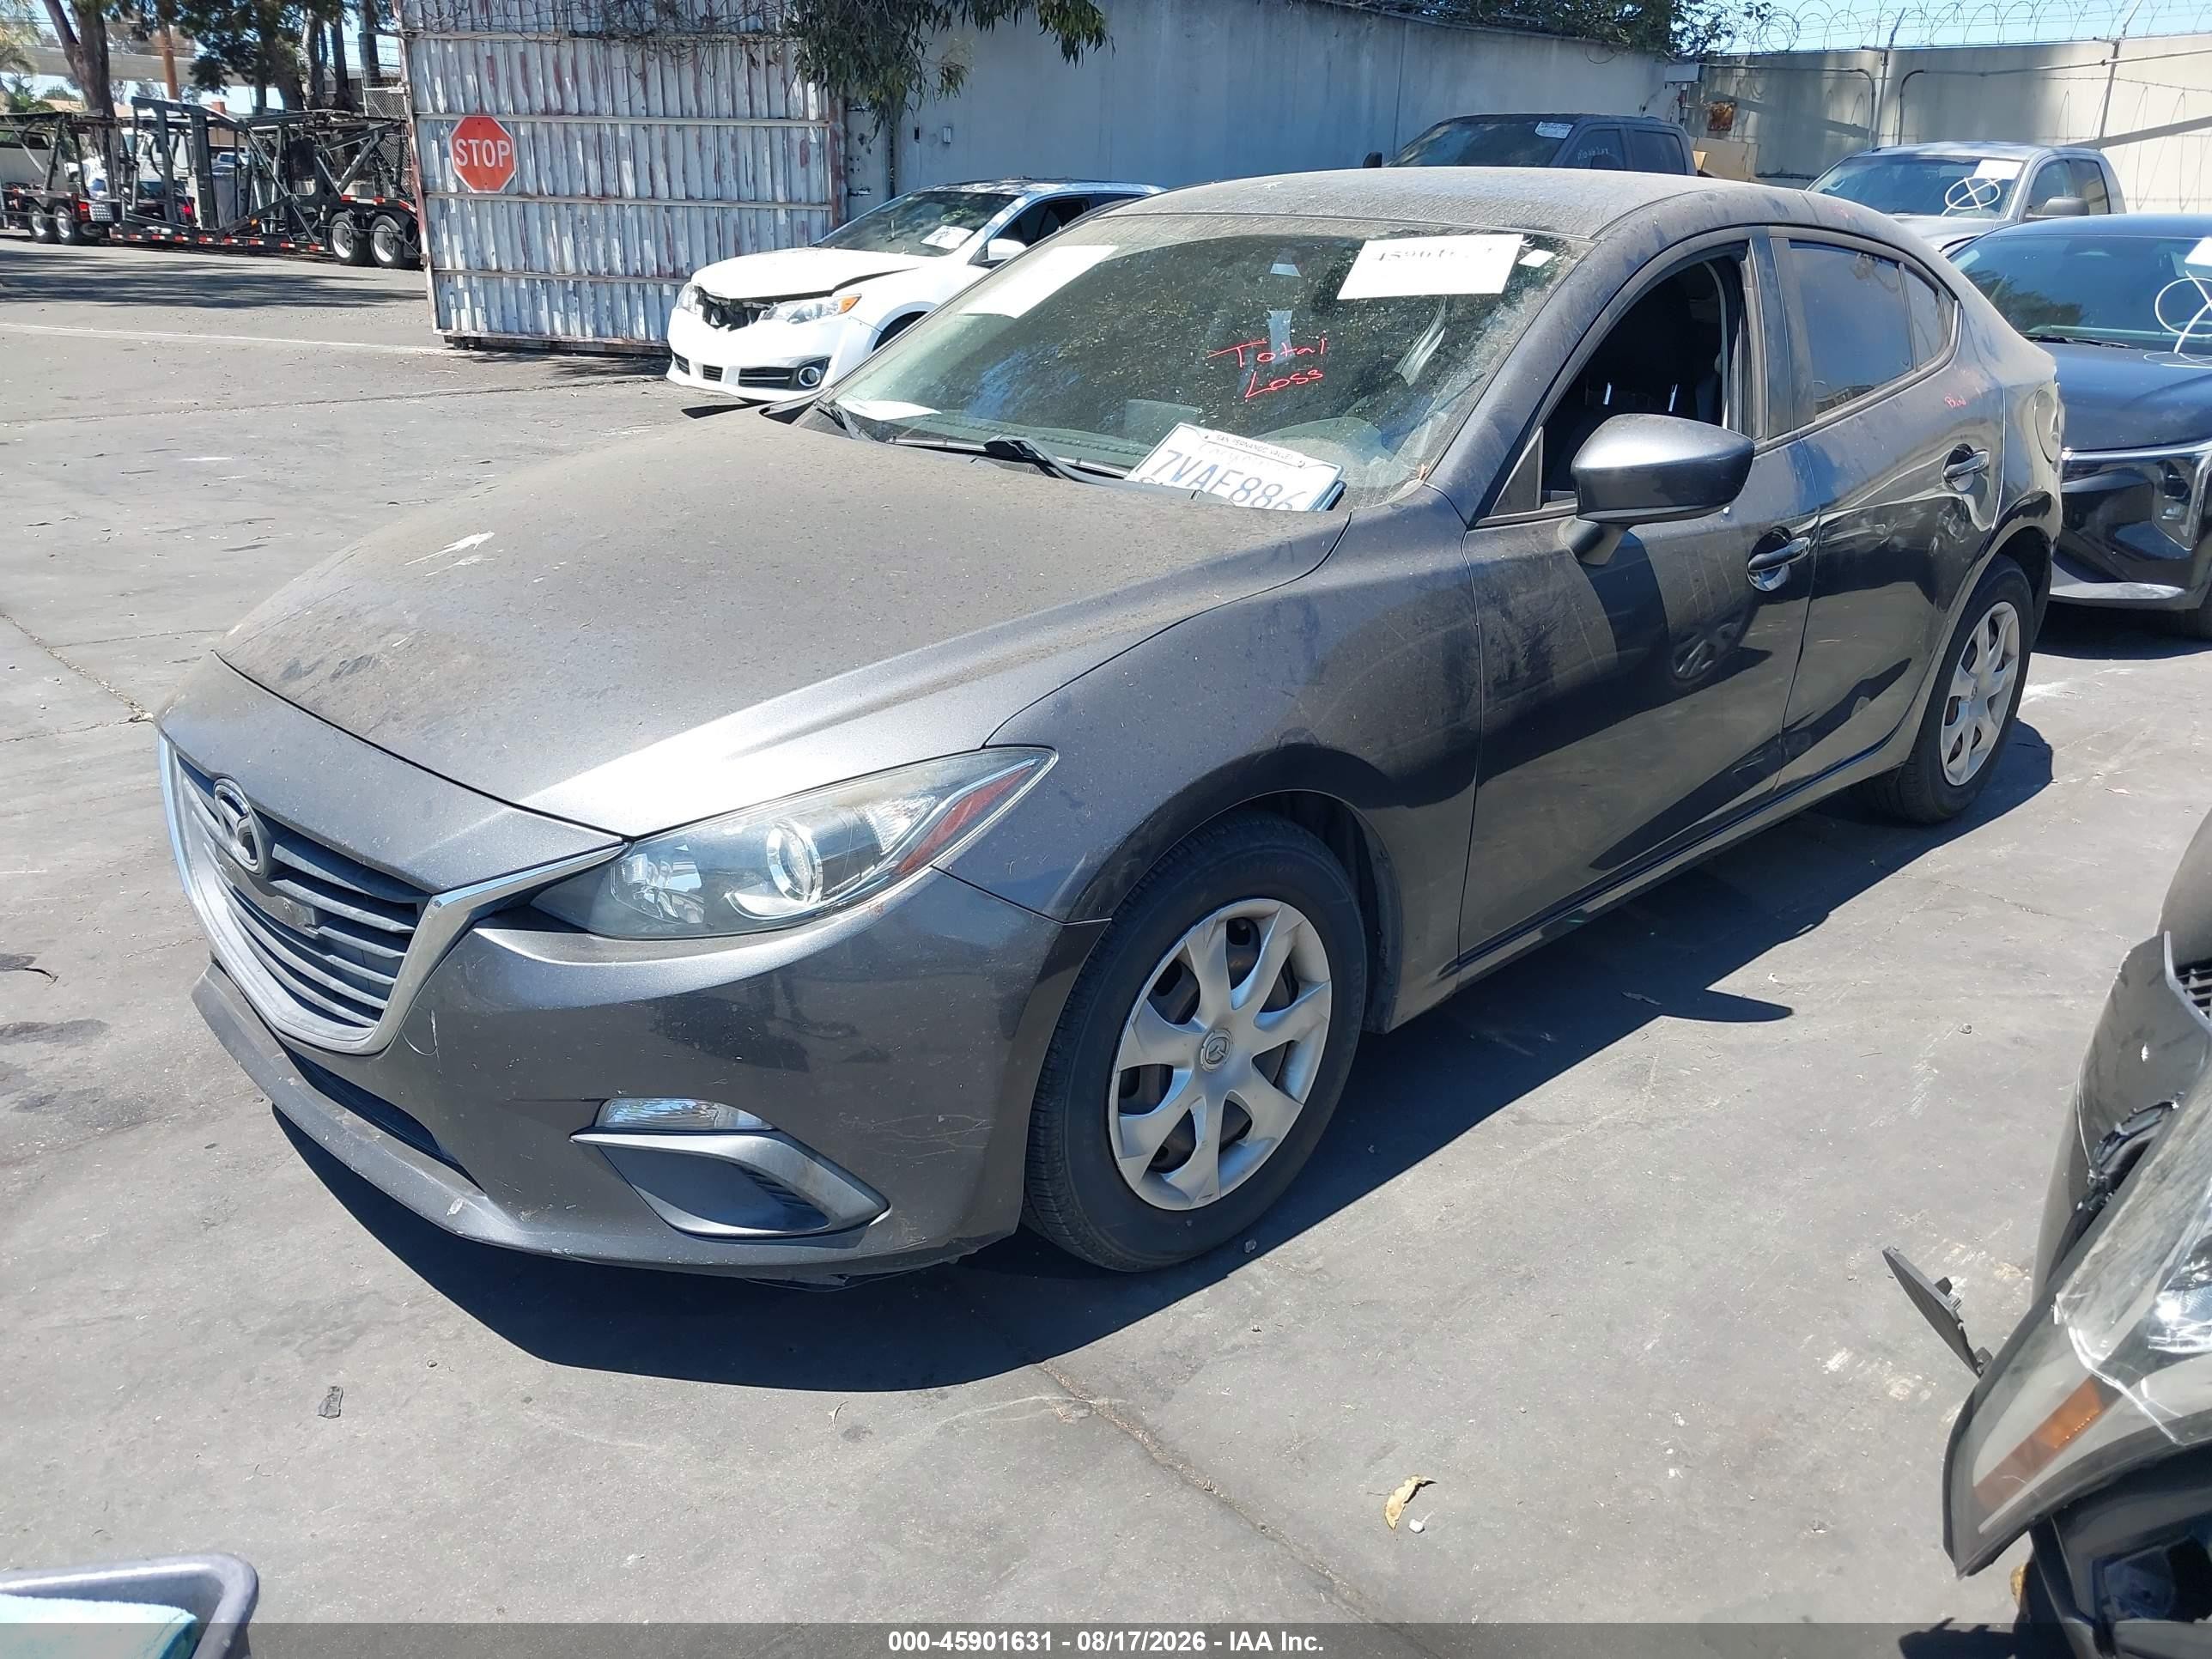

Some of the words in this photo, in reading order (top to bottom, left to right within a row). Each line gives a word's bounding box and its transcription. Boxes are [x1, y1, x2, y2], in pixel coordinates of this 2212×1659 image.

[455, 138, 511, 167] STOP
[1206, 337, 1326, 368] Total
[1244, 369, 1323, 398] Loss
[1216, 434, 1229, 442] SAN
